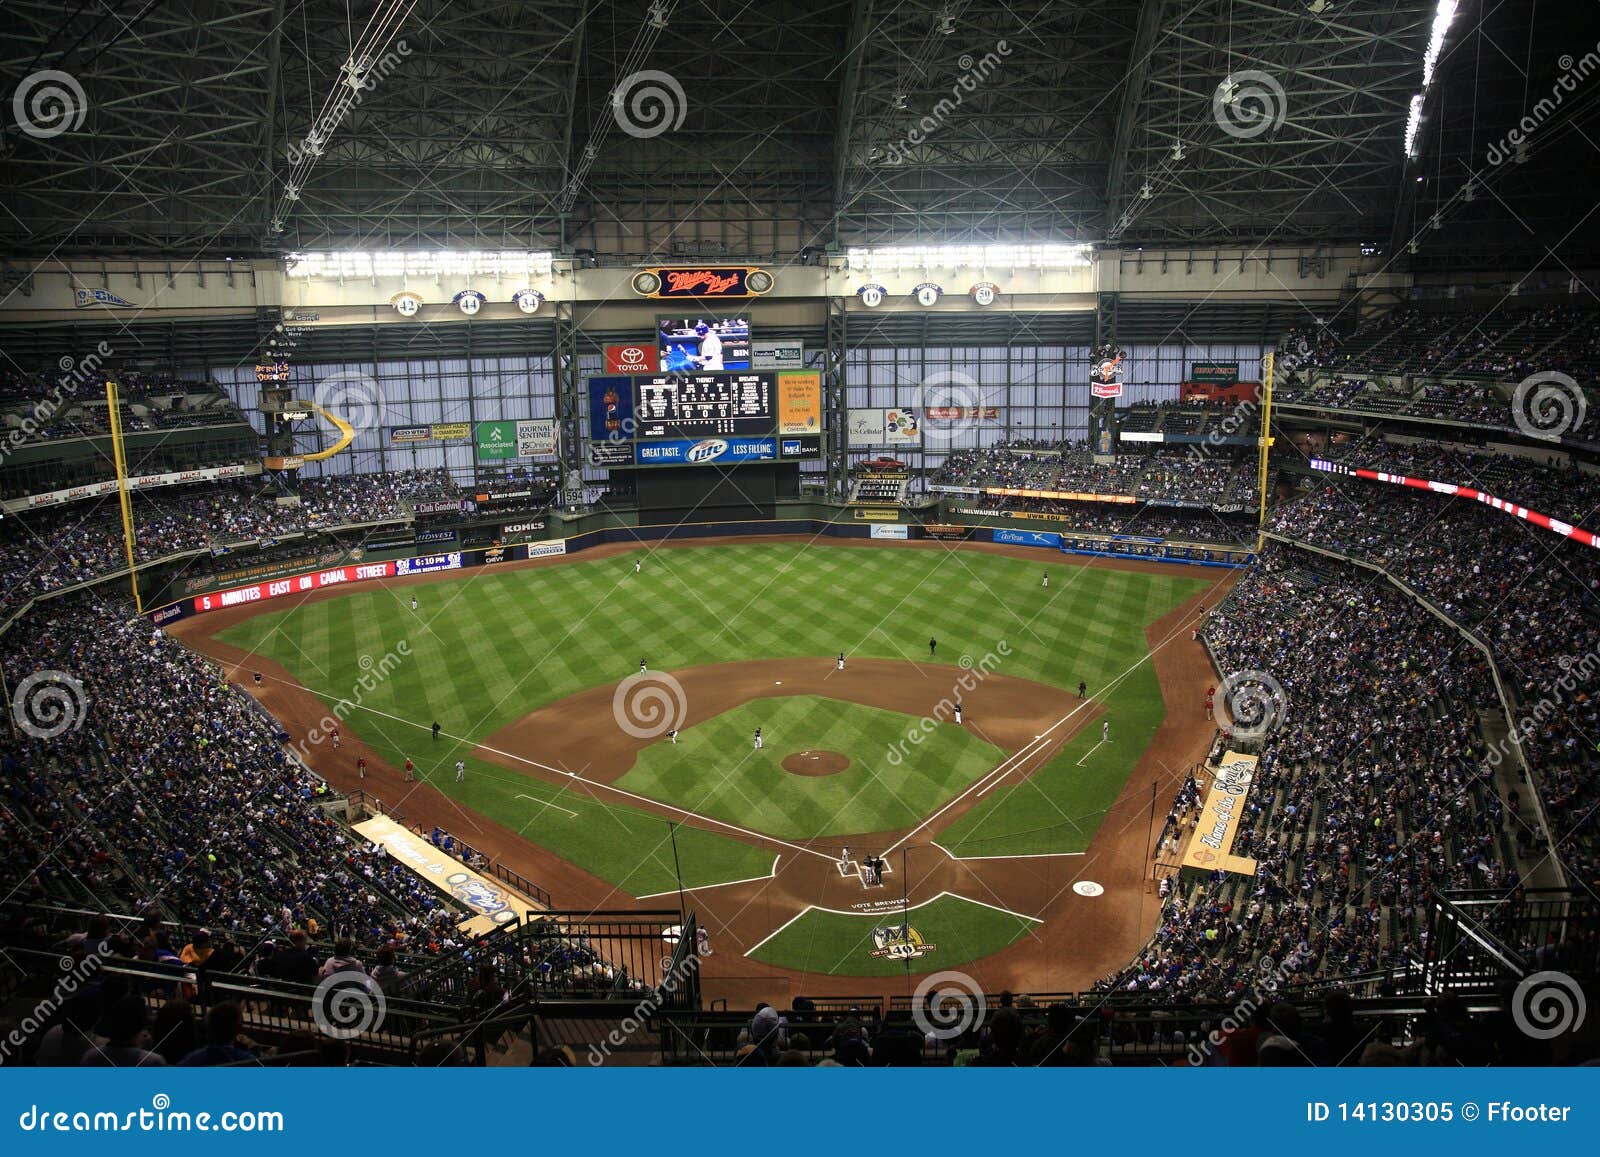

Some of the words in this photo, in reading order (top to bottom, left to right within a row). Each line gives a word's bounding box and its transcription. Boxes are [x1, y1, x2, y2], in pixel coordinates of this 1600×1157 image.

[667, 271, 712, 292] Miller
[704, 273, 740, 294] Park
[866, 292, 879, 302] 19
[923, 292, 930, 302] 4
[979, 290, 991, 299] 50
[400, 300, 415, 311] 42
[462, 299, 476, 310] 44
[522, 297, 536, 309] 34
[520, 425, 551, 433] JOURNAL
[519, 431, 552, 440] SENTINEL
[480, 441, 514, 449] Associated
[733, 445, 748, 454] LESS
[642, 448, 660, 458] GREAT
[419, 502, 434, 512] Club
[504, 521, 545, 533] KOHL'S
[415, 557, 435, 566] 6:10
[486, 556, 504, 564] CHEVY
[203, 596, 211, 610] 5
[221, 586, 261, 606] MINUTES
[269, 580, 291, 596] EAST
[299, 576, 312, 590] ON
[320, 569, 347, 585] CANAL
[356, 563, 387, 579] STREET
[1200, 821, 1228, 849] Home
